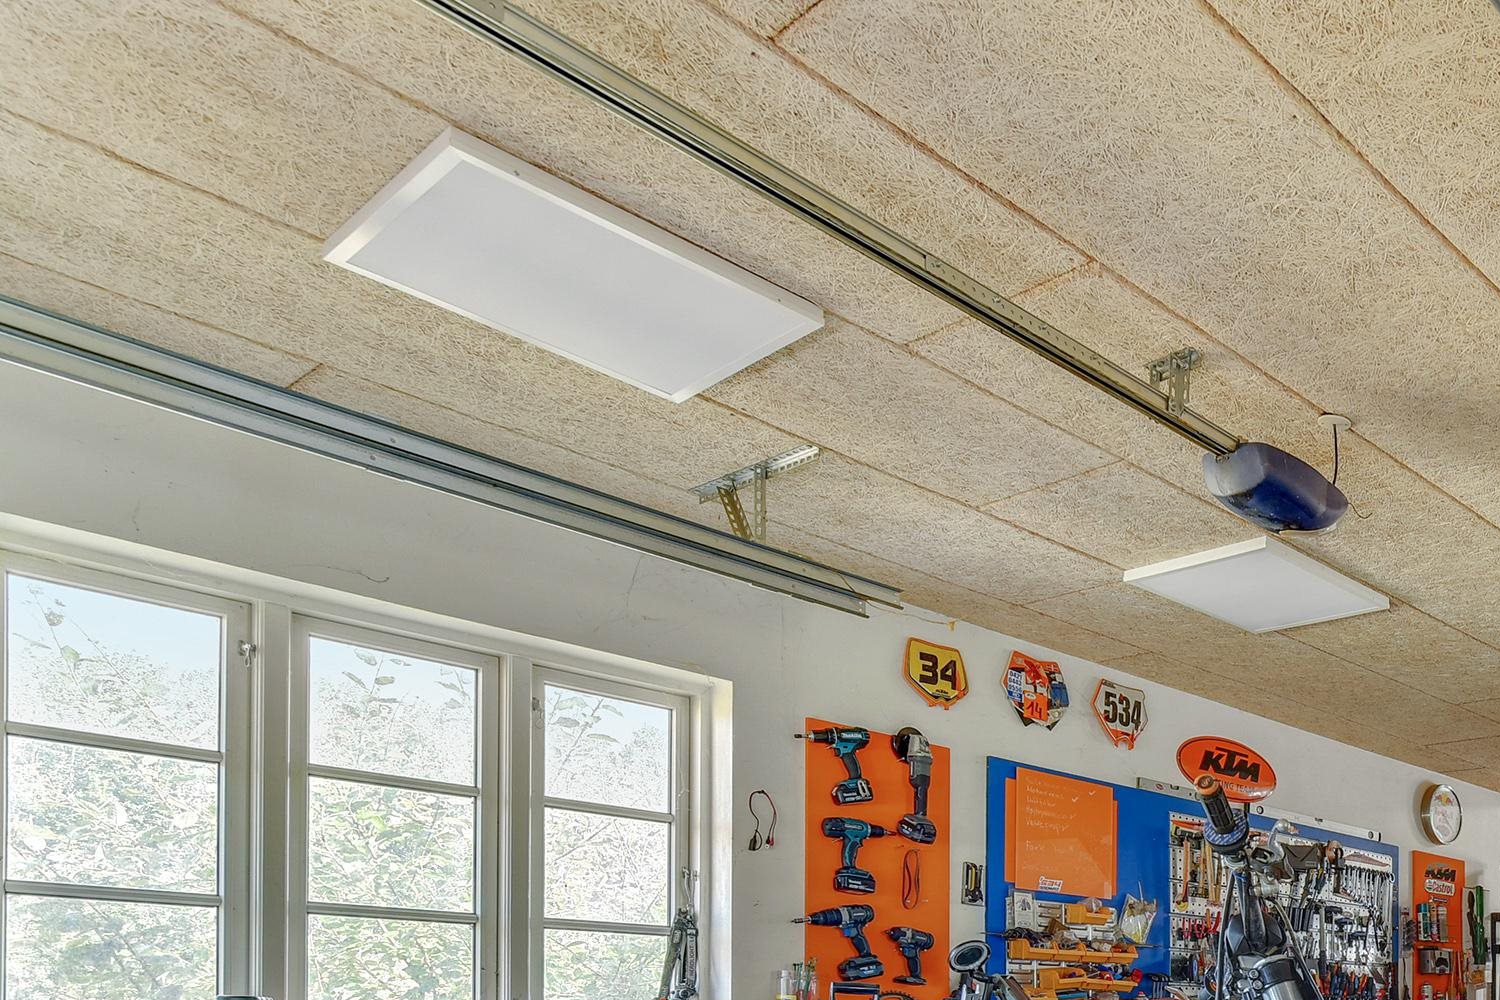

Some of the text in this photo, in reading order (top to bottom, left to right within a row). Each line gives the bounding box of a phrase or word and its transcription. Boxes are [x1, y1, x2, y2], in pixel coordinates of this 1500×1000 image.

[918, 651, 957, 690] 34
[1026, 701, 1042, 719] 14
[1103, 691, 1142, 731] 534
[1200, 746, 1261, 783] KTM
[1433, 882, 1453, 896] Castrol
